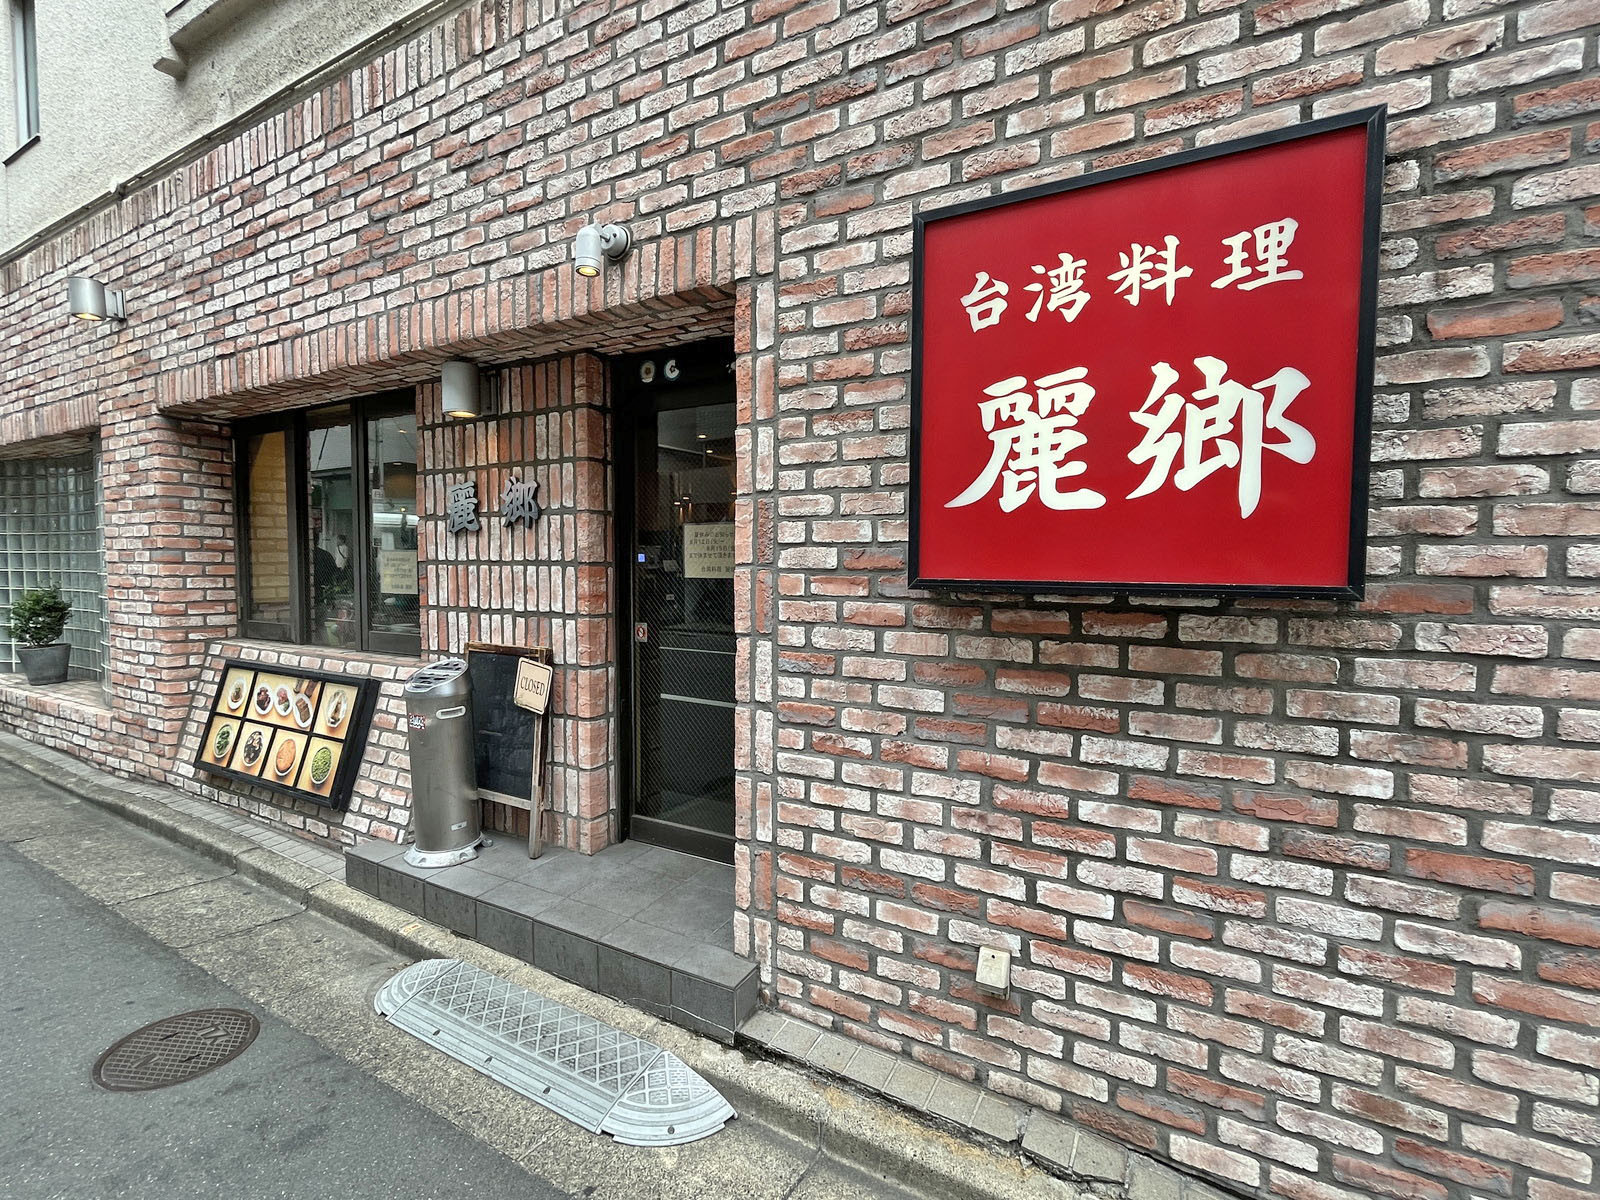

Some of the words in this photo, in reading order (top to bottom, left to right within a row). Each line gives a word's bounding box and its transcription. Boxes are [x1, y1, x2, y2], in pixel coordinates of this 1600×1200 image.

[959, 217, 1304, 333] 台湾料理
[520, 676, 546, 697] CLOSED
